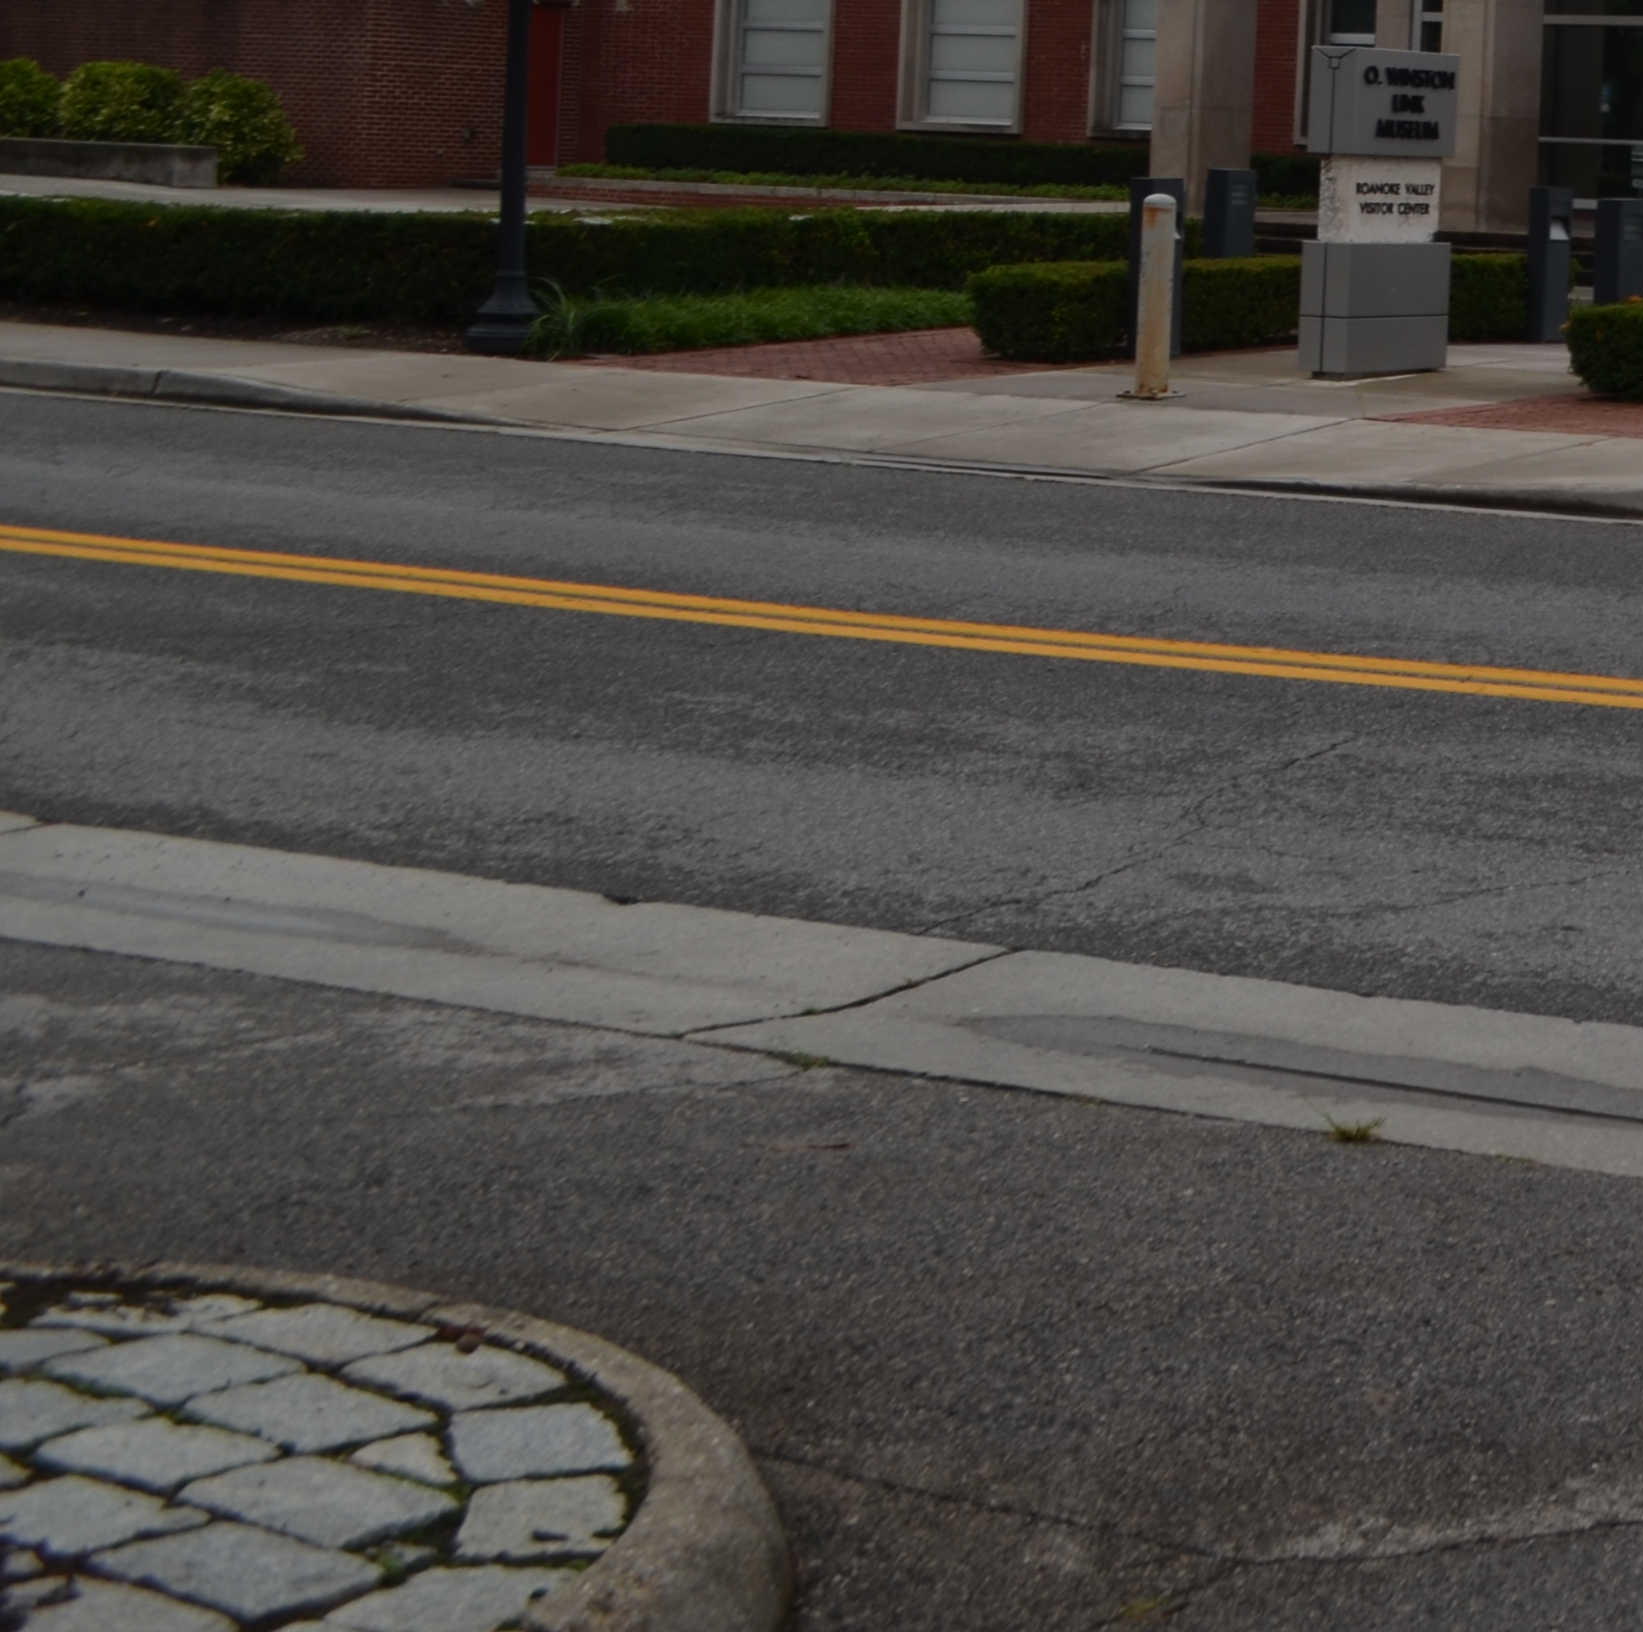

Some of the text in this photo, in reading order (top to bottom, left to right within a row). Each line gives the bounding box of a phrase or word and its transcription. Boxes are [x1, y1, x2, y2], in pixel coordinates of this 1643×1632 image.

[1364, 65, 1455, 90] O. WINSTON
[1392, 94, 1426, 113] LINK
[1376, 119, 1439, 139] MUSEUM
[1356, 182, 1434, 196] ROANOKE VALLEY
[1360, 202, 1430, 215] VISITOR CENTER
